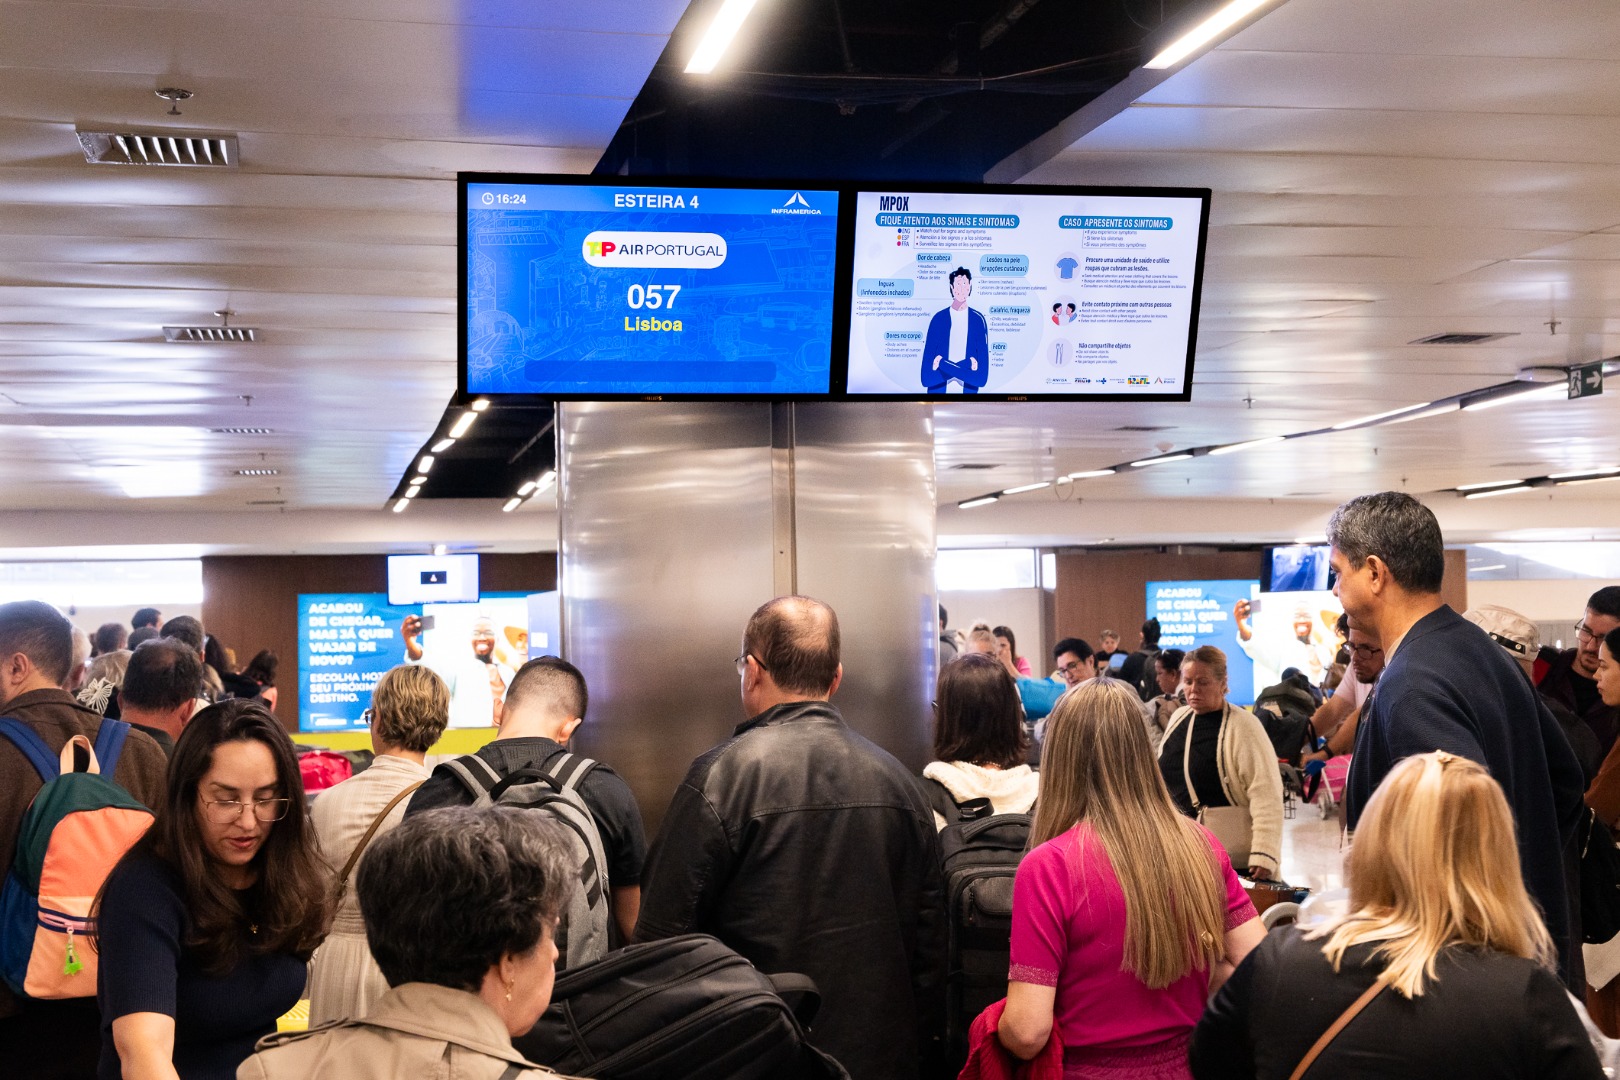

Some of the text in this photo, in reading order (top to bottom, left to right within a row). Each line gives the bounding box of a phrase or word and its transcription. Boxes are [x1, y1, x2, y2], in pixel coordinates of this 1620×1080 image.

[496, 194, 526, 205] 16:24
[614, 194, 699, 209] ESTEIRA 4
[880, 196, 909, 211] MPOX
[880, 216, 1015, 226] FIQUE ATENTO AOS SINAIS E SINTOMAS
[1064, 218, 1167, 228] CASO APRESENTE OS SINTOMAS
[587, 242, 616, 257] TAP
[627, 284, 682, 309] 057
[624, 317, 682, 332] Lisboa
[1156, 588, 1202, 598] ACABOU
[309, 603, 364, 614] ACABOU
[1157, 600, 1220, 611] DE CHEGAR,
[309, 616, 385, 628] DE CHEGAR,
[1157, 610, 1228, 623] MAS JÁ QUER
[1198, 624, 1213, 633] DE
[310, 627, 393, 642] MAS JÁ QUER
[310, 642, 376, 653] VIAJAR DE
[310, 655, 354, 666] NOVO?
[310, 673, 359, 683] ESCOLHA
[310, 680, 376, 692] SEU PRÓXIM
[310, 693, 359, 703] DESTINO.
